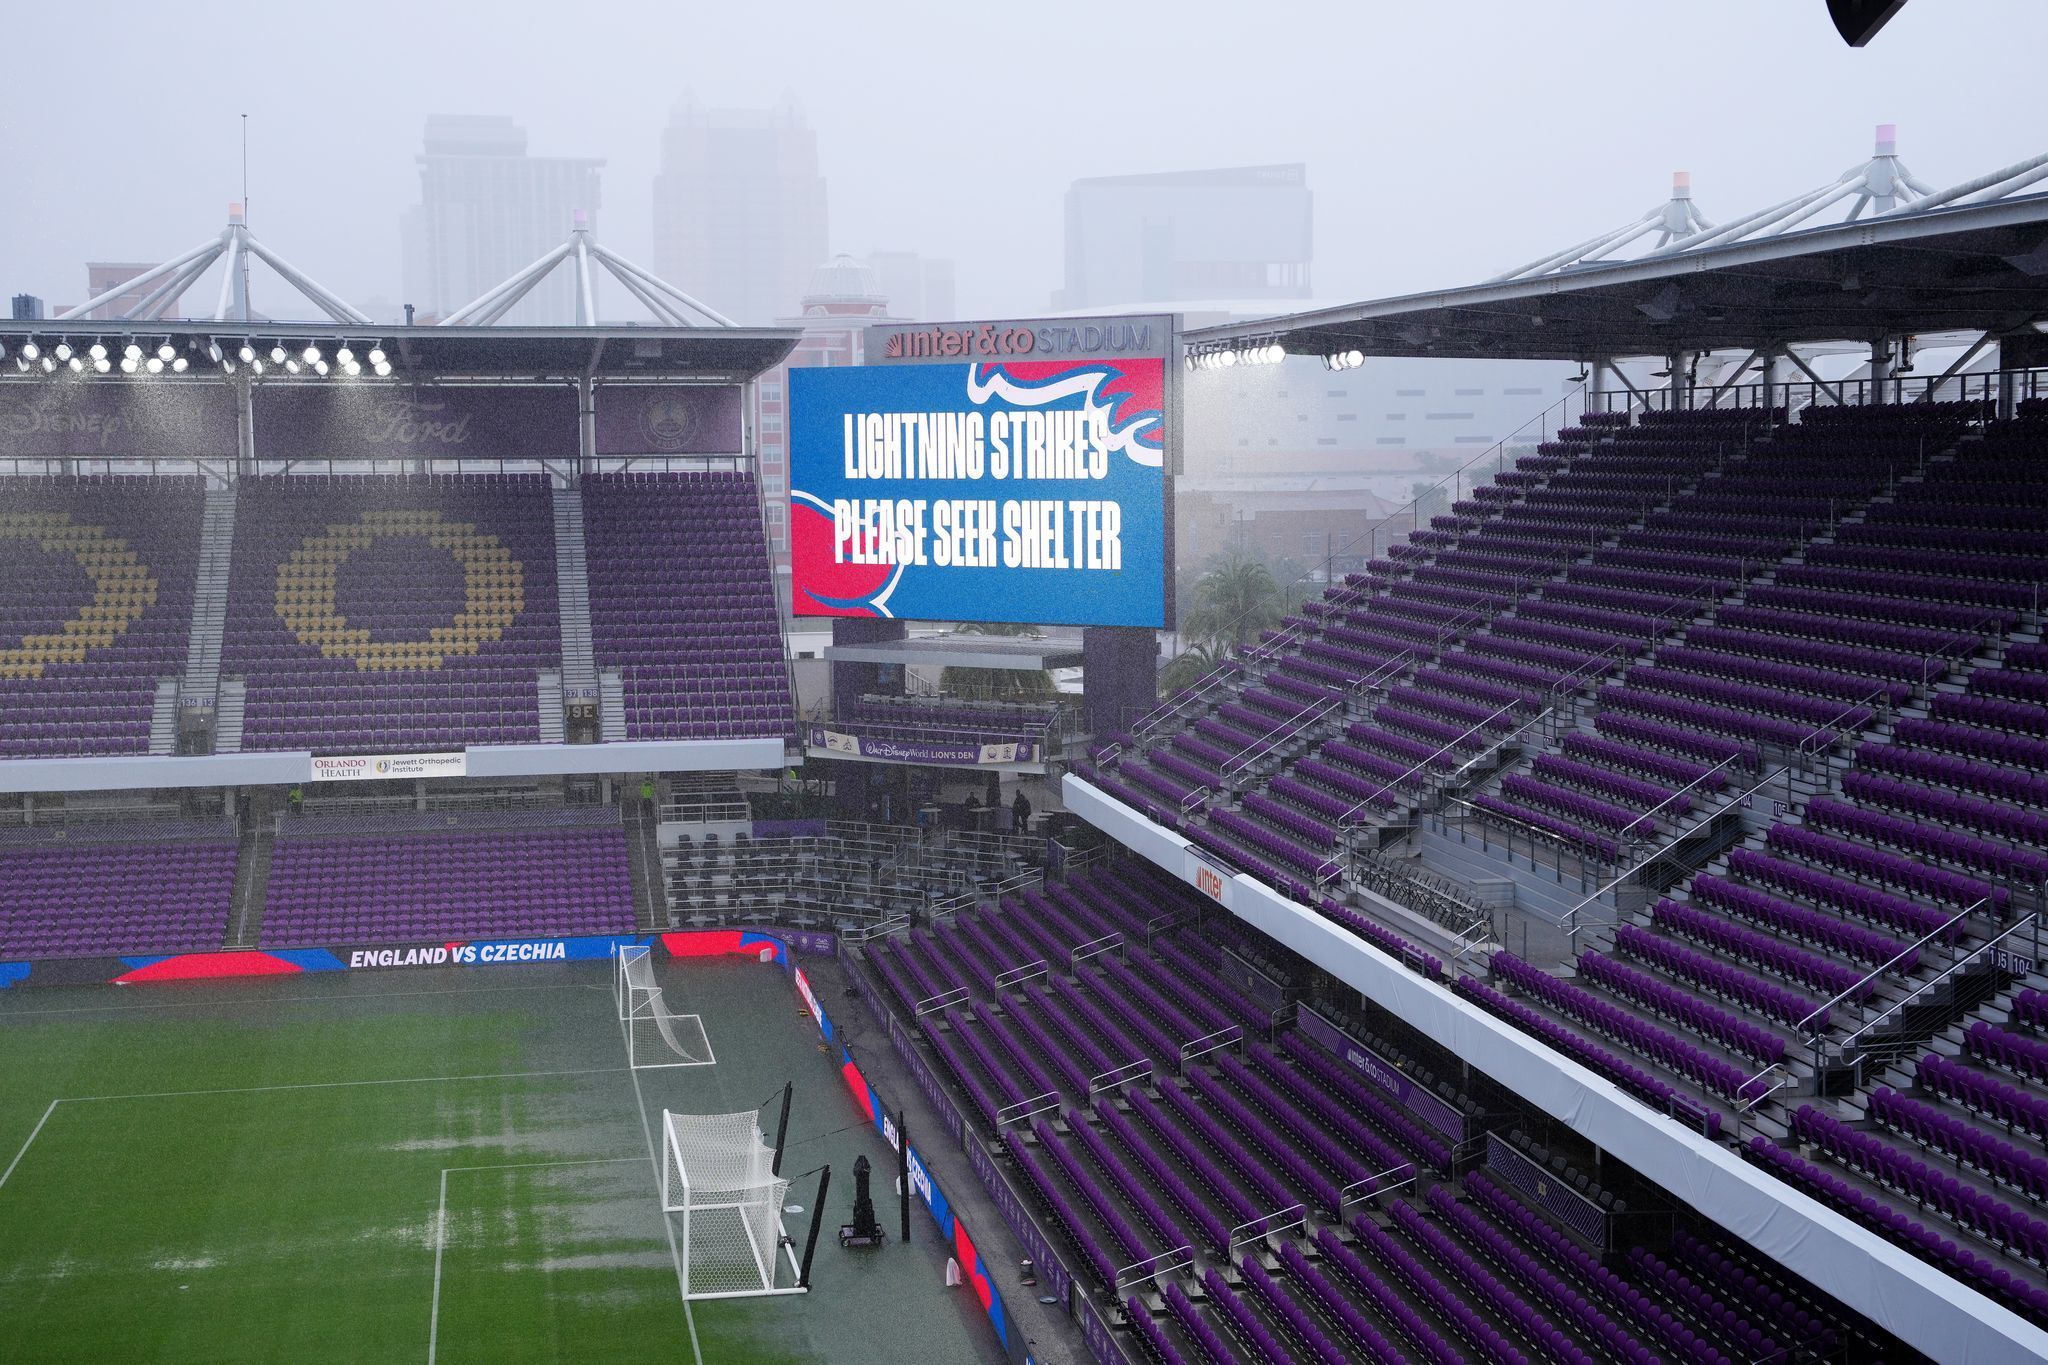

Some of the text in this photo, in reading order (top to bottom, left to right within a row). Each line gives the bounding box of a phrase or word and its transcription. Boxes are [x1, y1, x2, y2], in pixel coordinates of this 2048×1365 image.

[1038, 325, 1152, 353] STADIUM
[367, 400, 473, 443] Ford
[844, 410, 1109, 480] LIGHTNING STRIKES
[834, 499, 1122, 570] PLEASE SEEK SHELTER
[583, 689, 598, 697] 138
[419, 757, 462, 766] Orthopedic
[866, 742, 884, 753] Walt
[883, 744, 910, 760] Disney
[909, 749, 929, 758] World
[931, 752, 956, 760] LION'S
[350, 942, 566, 968] ENGLAND VS CZECHIA
[1376, 1068, 1400, 1095] STADIUM
